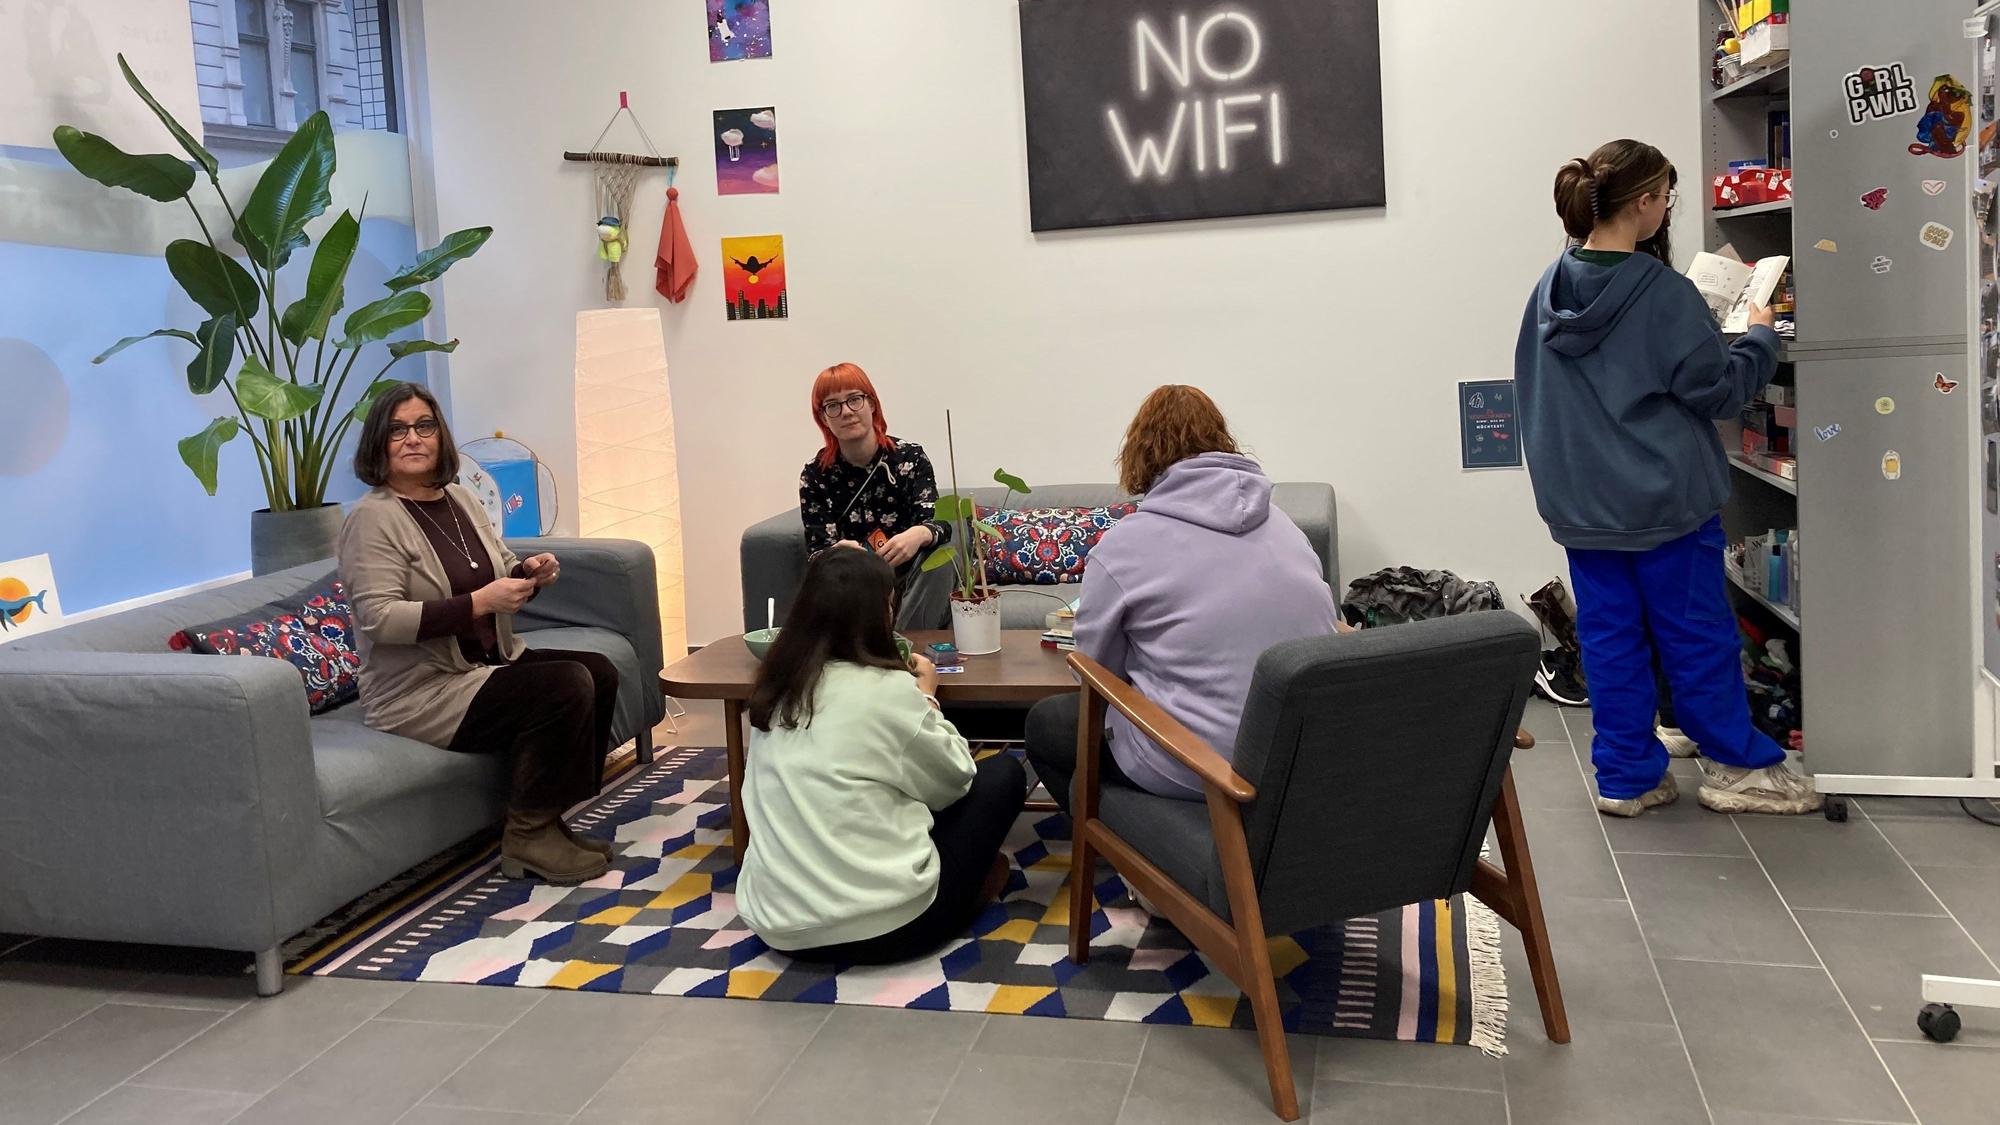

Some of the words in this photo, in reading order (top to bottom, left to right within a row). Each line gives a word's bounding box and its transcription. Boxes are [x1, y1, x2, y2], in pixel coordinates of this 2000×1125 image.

[1135, 10, 1261, 92] NO
[1846, 65, 1911, 98] GRL
[1850, 87, 1915, 121] PWR
[1107, 91, 1282, 178] WIFI
[1926, 224, 1949, 240] GOOD
[1815, 423, 1840, 440] love
